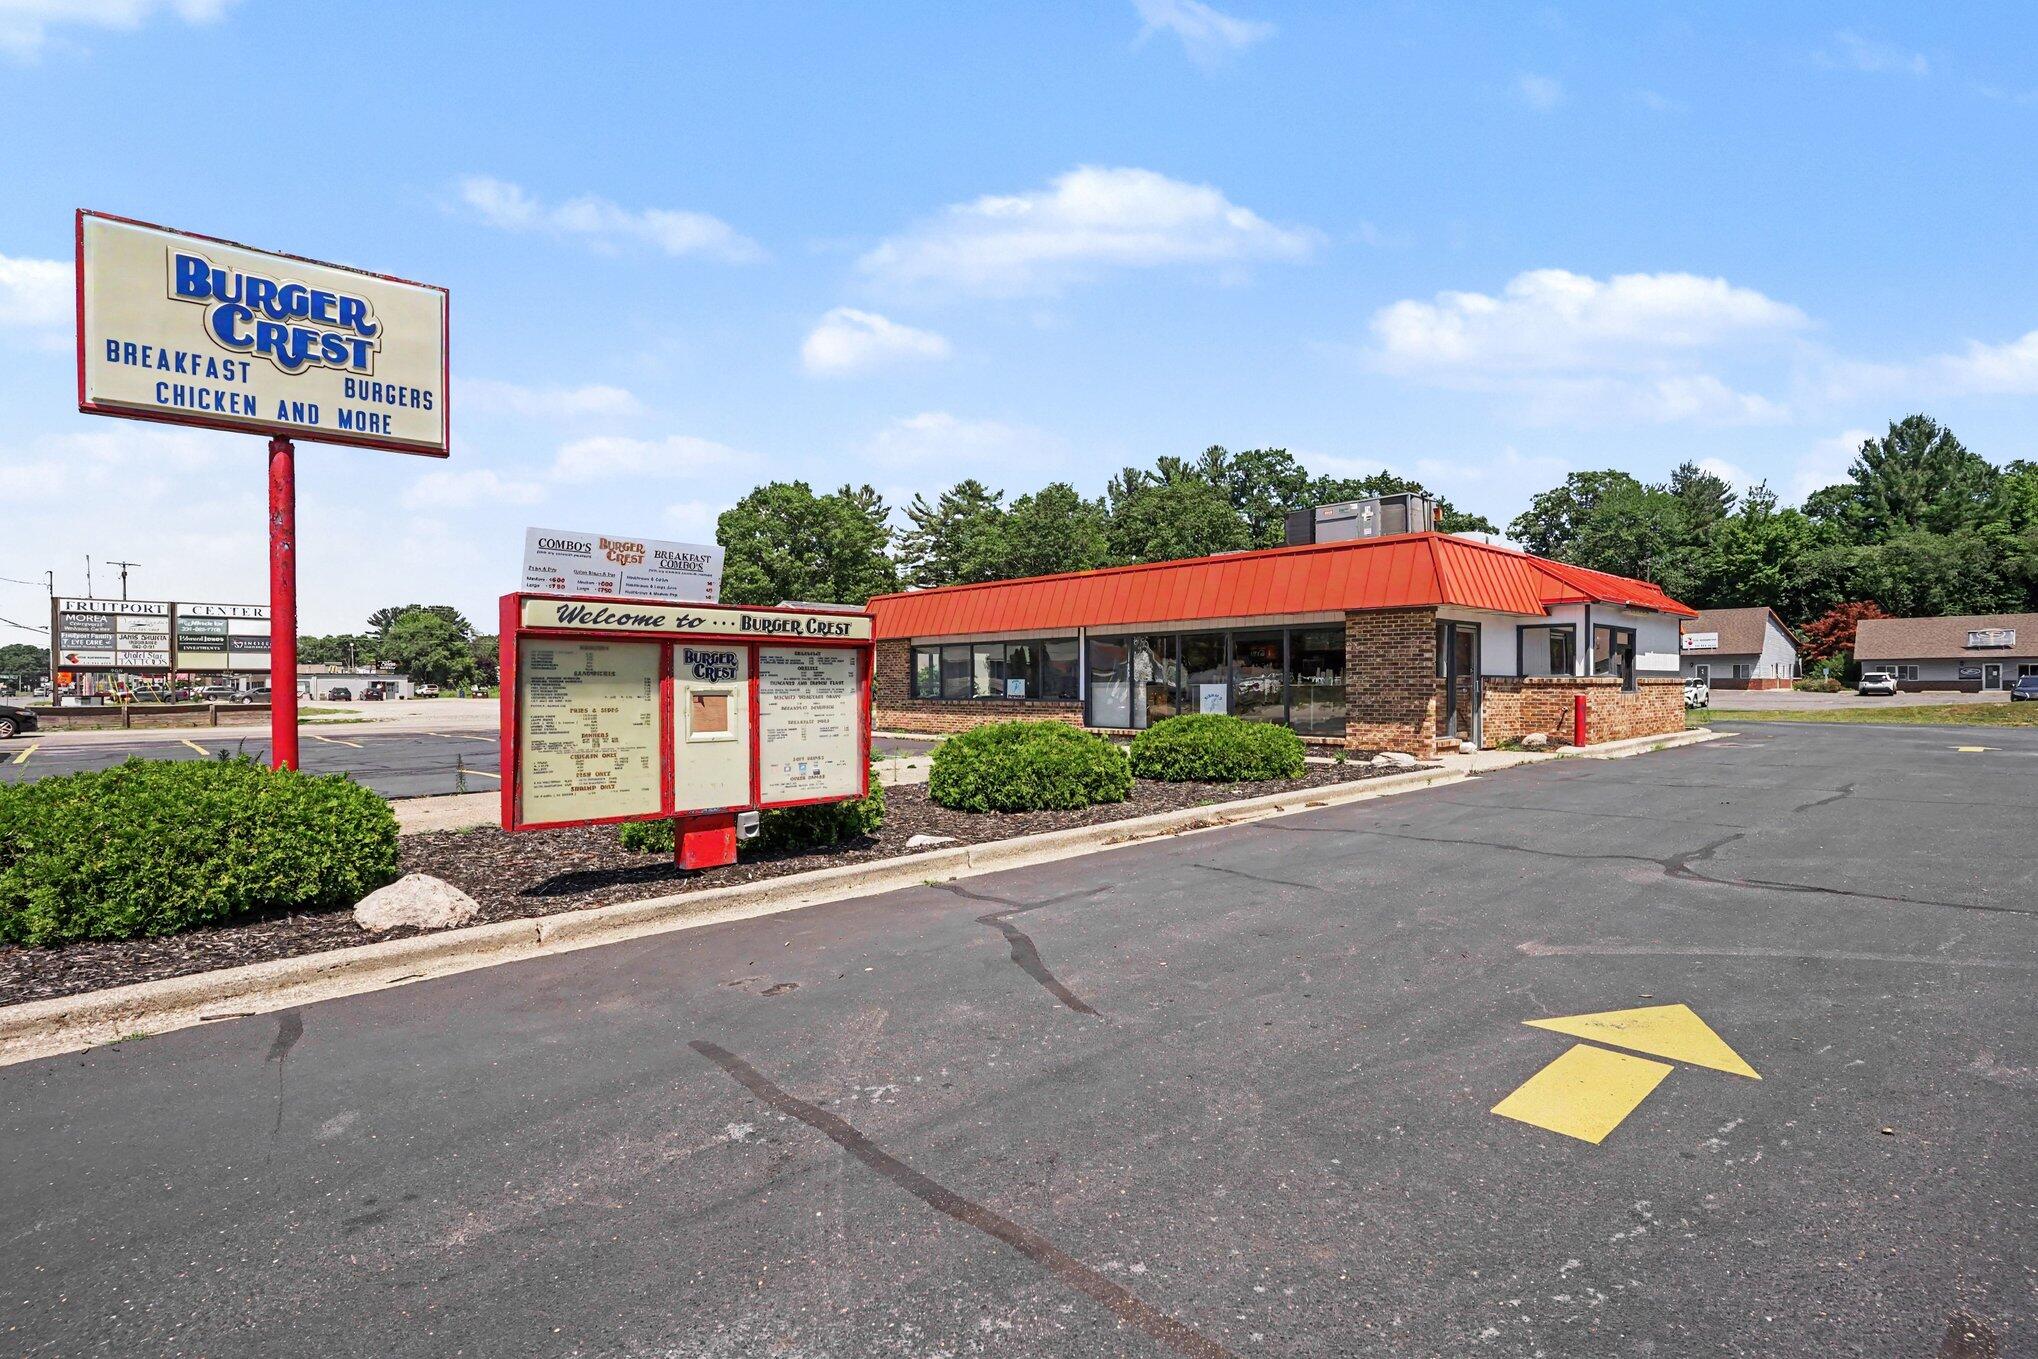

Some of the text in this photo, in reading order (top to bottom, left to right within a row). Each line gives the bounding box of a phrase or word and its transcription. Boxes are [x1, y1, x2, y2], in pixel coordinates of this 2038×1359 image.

[175, 253, 377, 337] BURGER
[212, 303, 374, 371] CREST
[106, 339, 251, 383] BREAKFAST
[344, 377, 434, 411] BURGERS
[156, 381, 392, 435] CHICKEN AND MORE
[538, 537, 592, 553] COMBO'S
[599, 537, 646, 555] BURGER
[606, 551, 645, 566] CREST
[654, 550, 712, 564] BREAKFAST
[660, 560, 704, 572] COMBO'S
[66, 601, 164, 614] FRUITPORT
[192, 606, 263, 617] CENTER
[65, 613, 108, 623] MOREA
[556, 603, 666, 626] Welcome
[676, 610, 706, 629] to
[740, 613, 803, 636] BURGER
[806, 619, 852, 638] CREST
[120, 658, 167, 666] TATTOOS
[684, 648, 738, 667] BURGER
[693, 663, 737, 682] CREST
